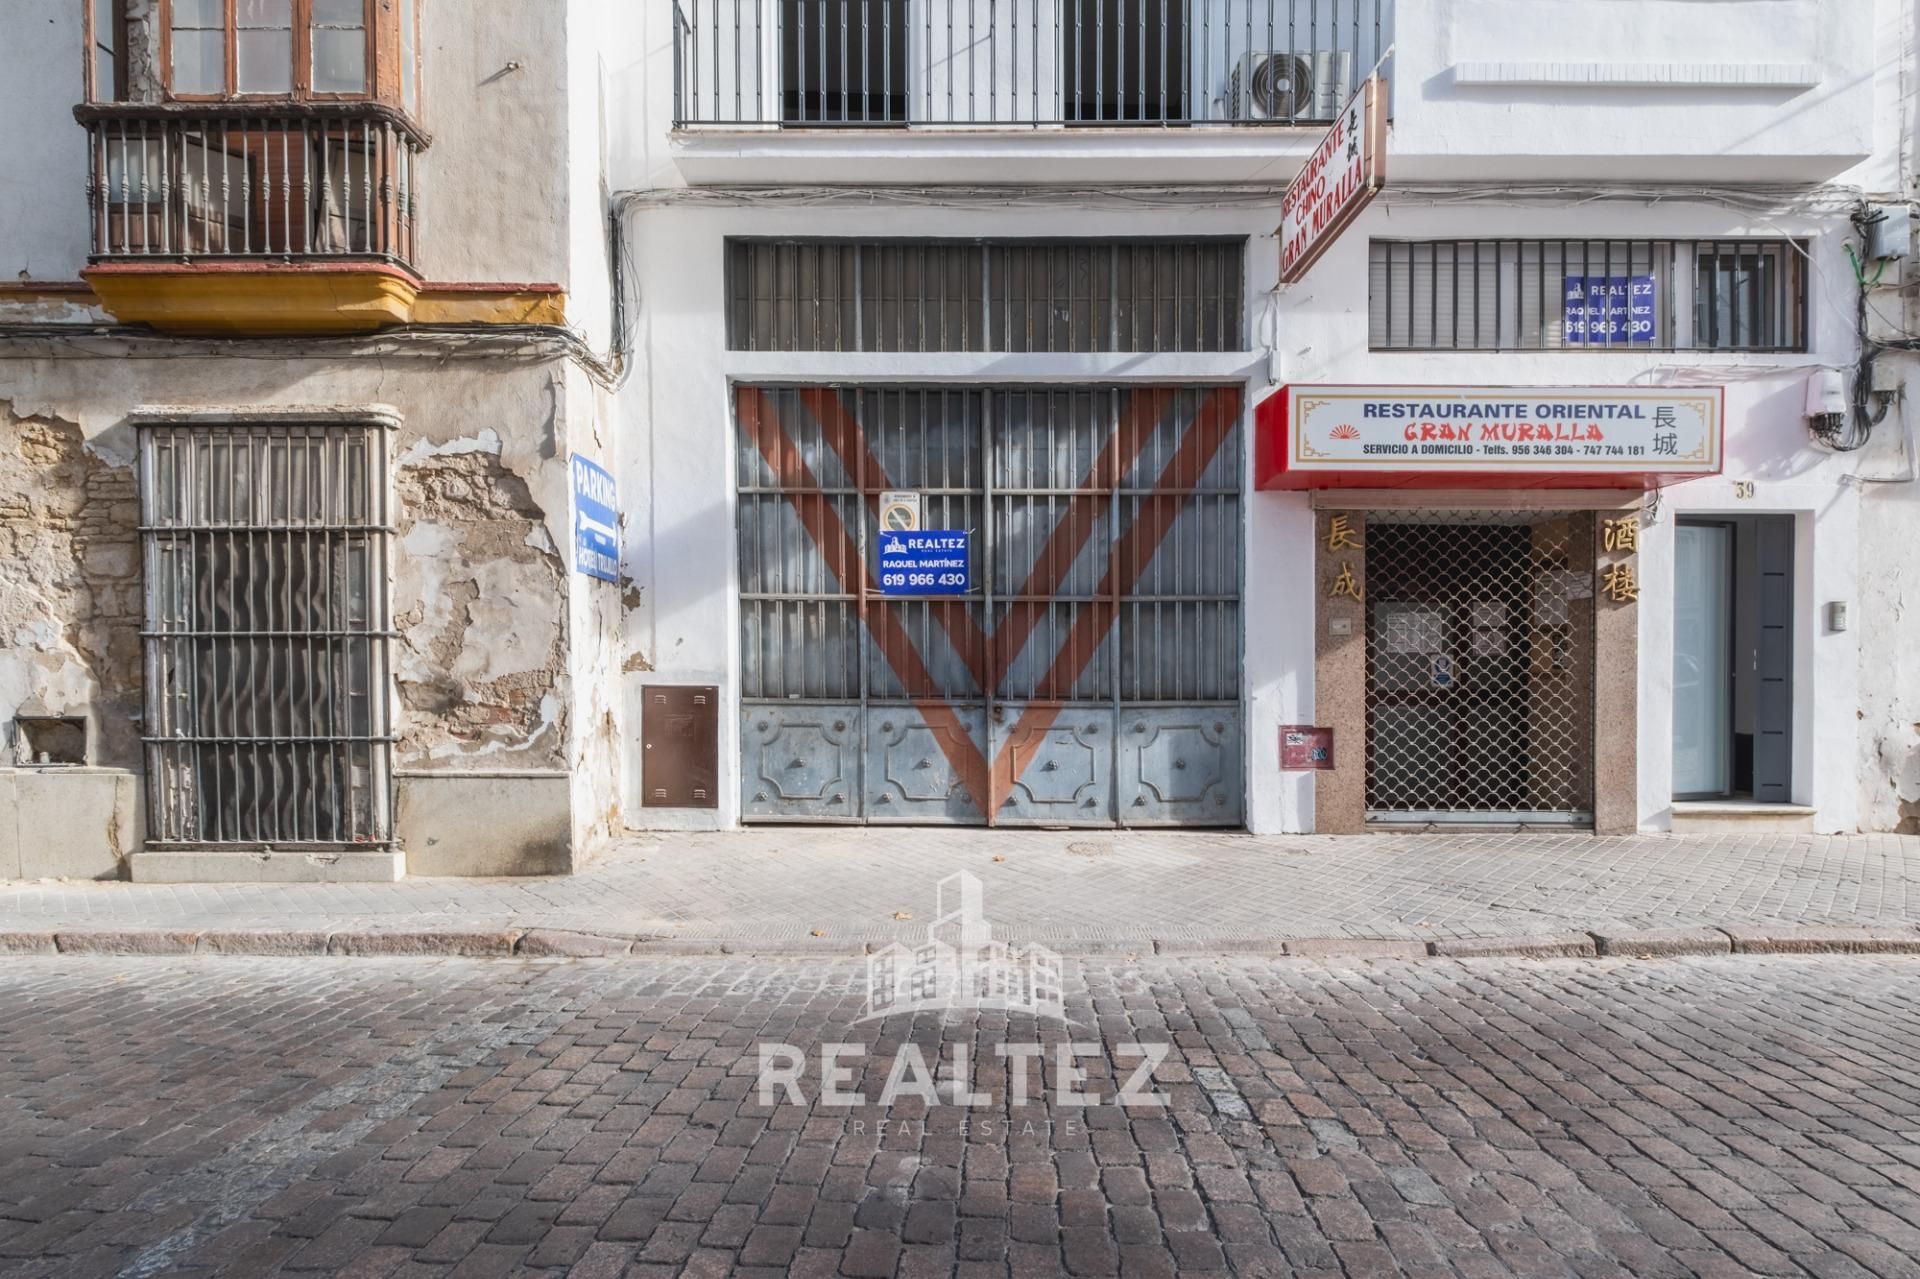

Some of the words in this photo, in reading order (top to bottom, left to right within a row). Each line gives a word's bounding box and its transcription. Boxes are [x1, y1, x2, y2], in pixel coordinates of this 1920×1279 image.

[1282, 119, 1344, 221] RESTAURANTE
[1296, 175, 1326, 226] CHINO
[1282, 222, 1307, 273] GRAN
[1311, 156, 1362, 240] MURALLA
[1363, 403, 1527, 419] RESTAURANTE
[1535, 403, 1646, 419] ORIENTAL
[1404, 422, 1472, 441] GRAN
[1480, 422, 1604, 442] MURALLA
[1651, 406, 1678, 456] 長城
[1363, 444, 1408, 455] SERVICIO
[1411, 444, 1418, 455] A
[1421, 444, 1473, 455] DOMICILIO
[1483, 444, 1508, 455] Telfs.
[1512, 444, 1531, 455] 956
[1533, 444, 1552, 455] 346
[1554, 444, 1574, 455] 304
[1583, 444, 1602, 456] 747
[1605, 444, 1624, 456] 744
[1627, 444, 1645, 456] 181
[575, 460, 615, 512] PARKING
[1736, 481, 1754, 499] 39
[908, 538, 965, 549] REALTEZ
[882, 560, 917, 568] RAQUEL
[919, 557, 964, 568] MARTÍNEZ
[883, 573, 905, 586] 619
[908, 573, 934, 586] 966
[938, 573, 965, 585] 430
